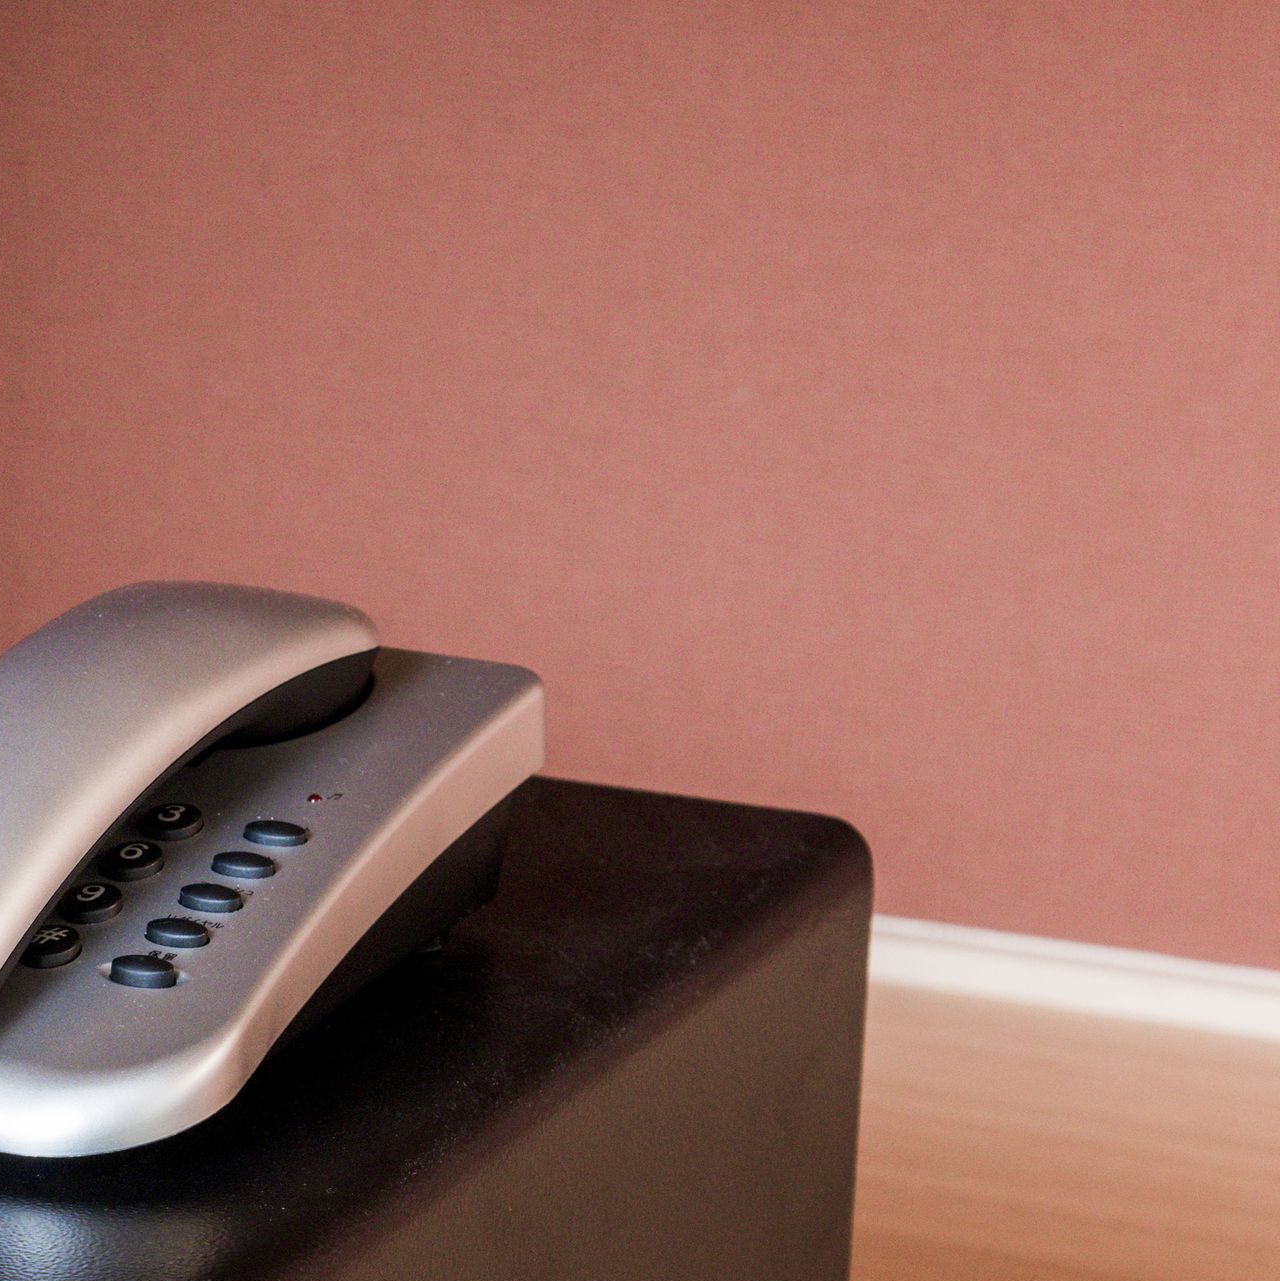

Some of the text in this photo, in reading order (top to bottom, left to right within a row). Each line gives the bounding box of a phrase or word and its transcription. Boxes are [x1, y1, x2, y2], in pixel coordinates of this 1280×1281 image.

[158, 805, 185, 821] 3
[120, 843, 148, 859] 6
[76, 885, 105, 901] 9
